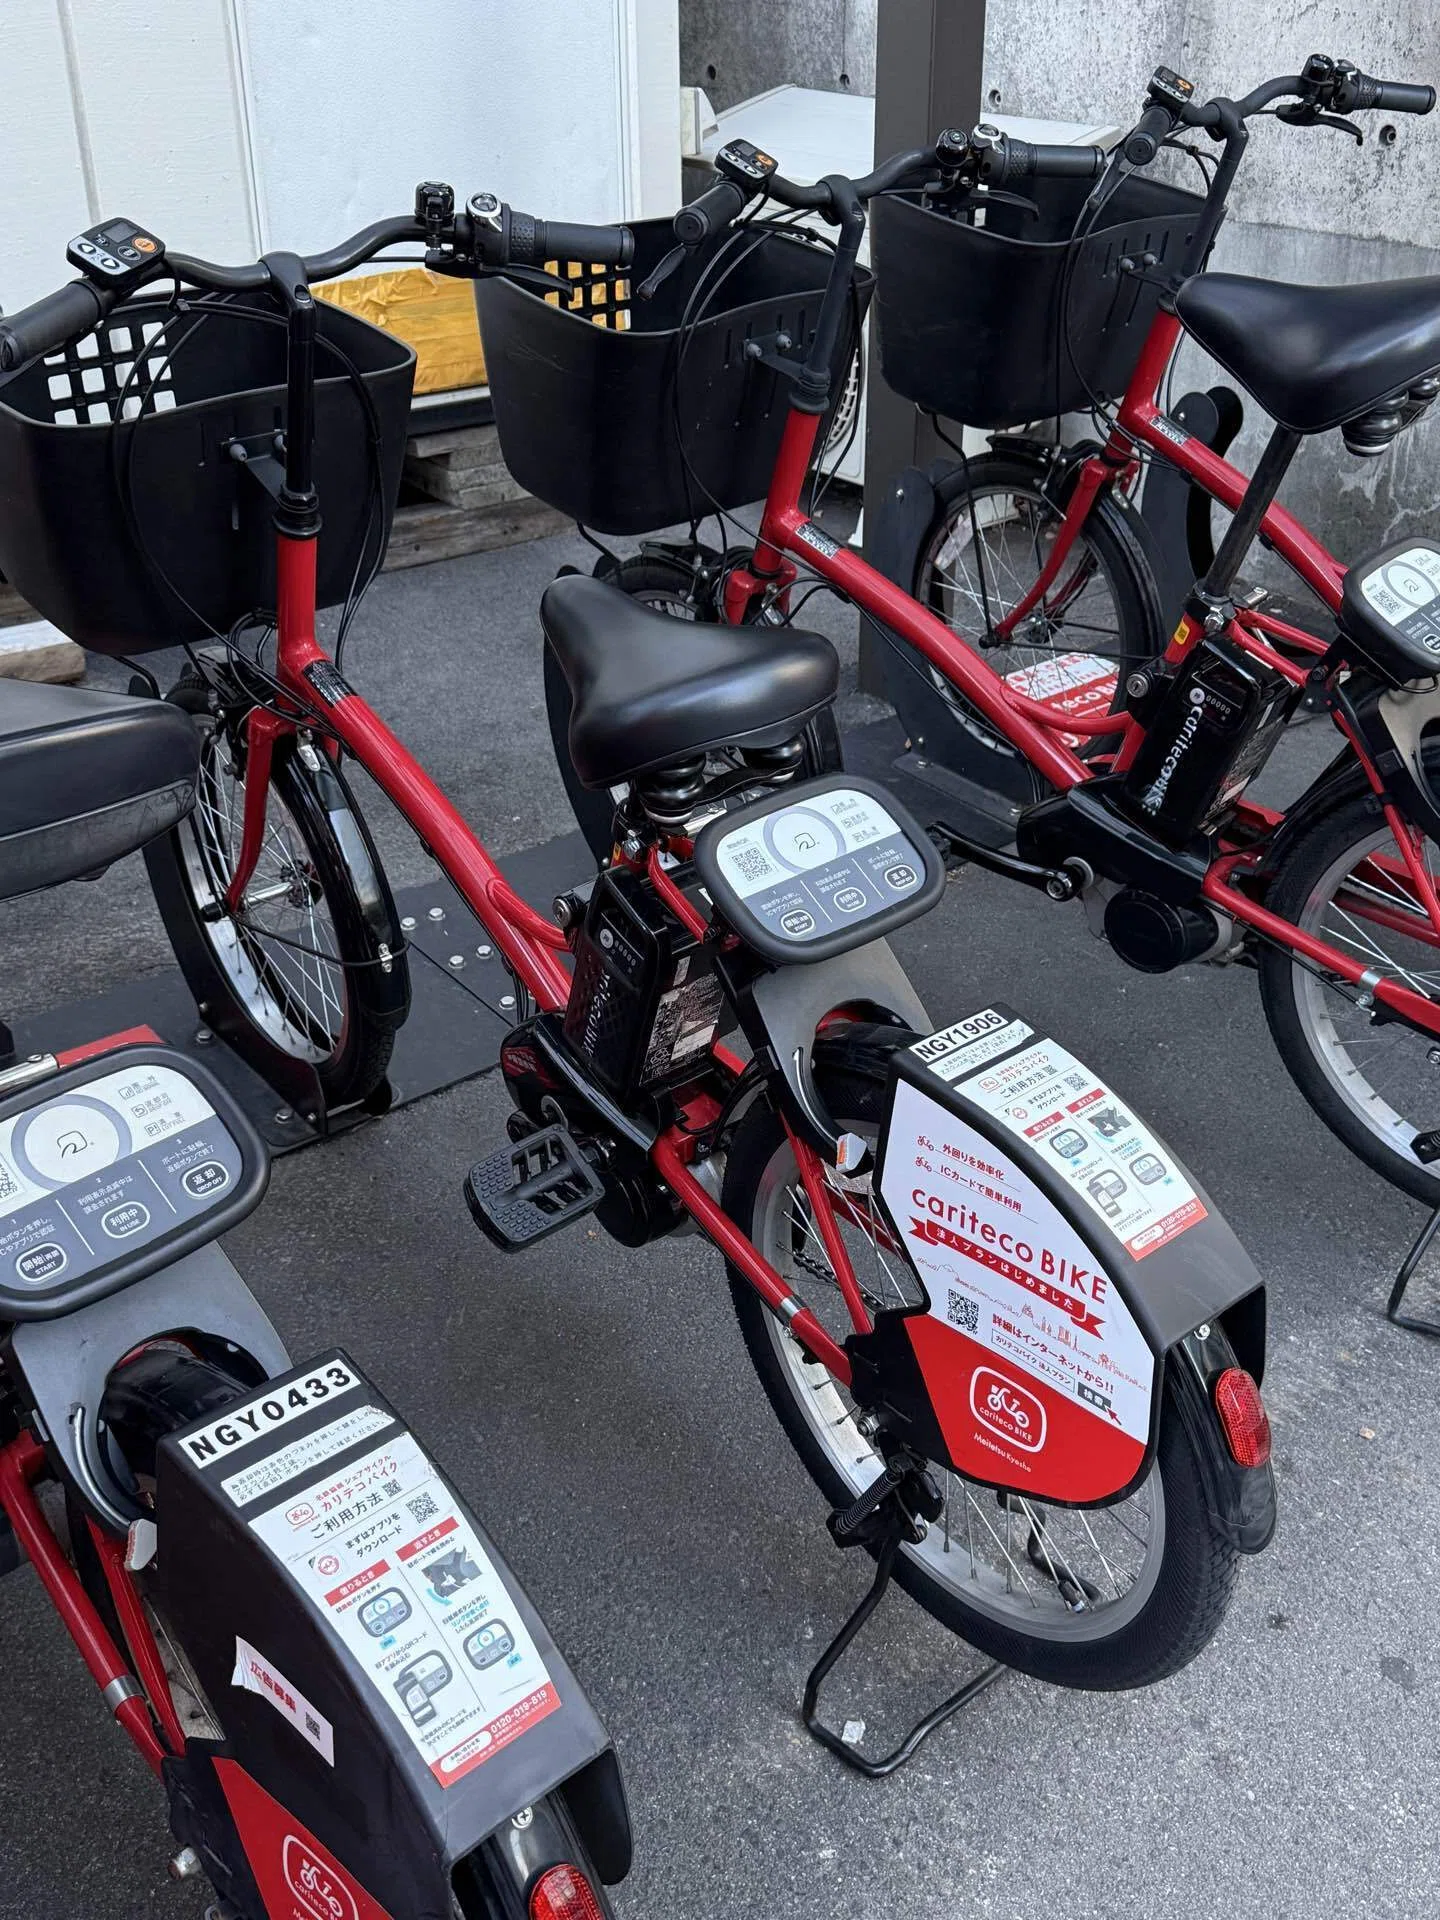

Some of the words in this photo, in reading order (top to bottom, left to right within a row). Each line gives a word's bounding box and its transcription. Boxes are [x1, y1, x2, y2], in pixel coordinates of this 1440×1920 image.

[916, 1013, 1003, 1059] NGY1906
[1000, 1072, 1045, 1098] ご利用方法
[192, 1168, 216, 1185] 返却
[942, 1144, 1005, 1181] 外回りを効率化
[940, 1164, 1023, 1213] ICカードで簡単利用
[111, 1208, 139, 1227] 利用中
[912, 1189, 1034, 1263] cariteco
[1041, 1249, 1108, 1305] BIKE
[35, 1261, 57, 1275] START
[936, 1227, 1075, 1311] 法人プランはじめました
[995, 1334, 1037, 1365] カリテコバイク
[1037, 1361, 1072, 1385] 法人プラン
[187, 1367, 351, 1461] NGY0433
[1083, 1387, 1103, 1409] 検索
[979, 1405, 1014, 1432] cariteco
[1013, 1427, 1033, 1443] BIKE
[321, 1462, 399, 1512] カリテコバイク
[310, 1492, 384, 1539] ご利用方法
[344, 1512, 401, 1550] まずはアプリを
[356, 1525, 403, 1559] ダウンロード
[339, 1570, 376, 1596] 借りるとき
[490, 1689, 548, 1734] 0120-019-819
